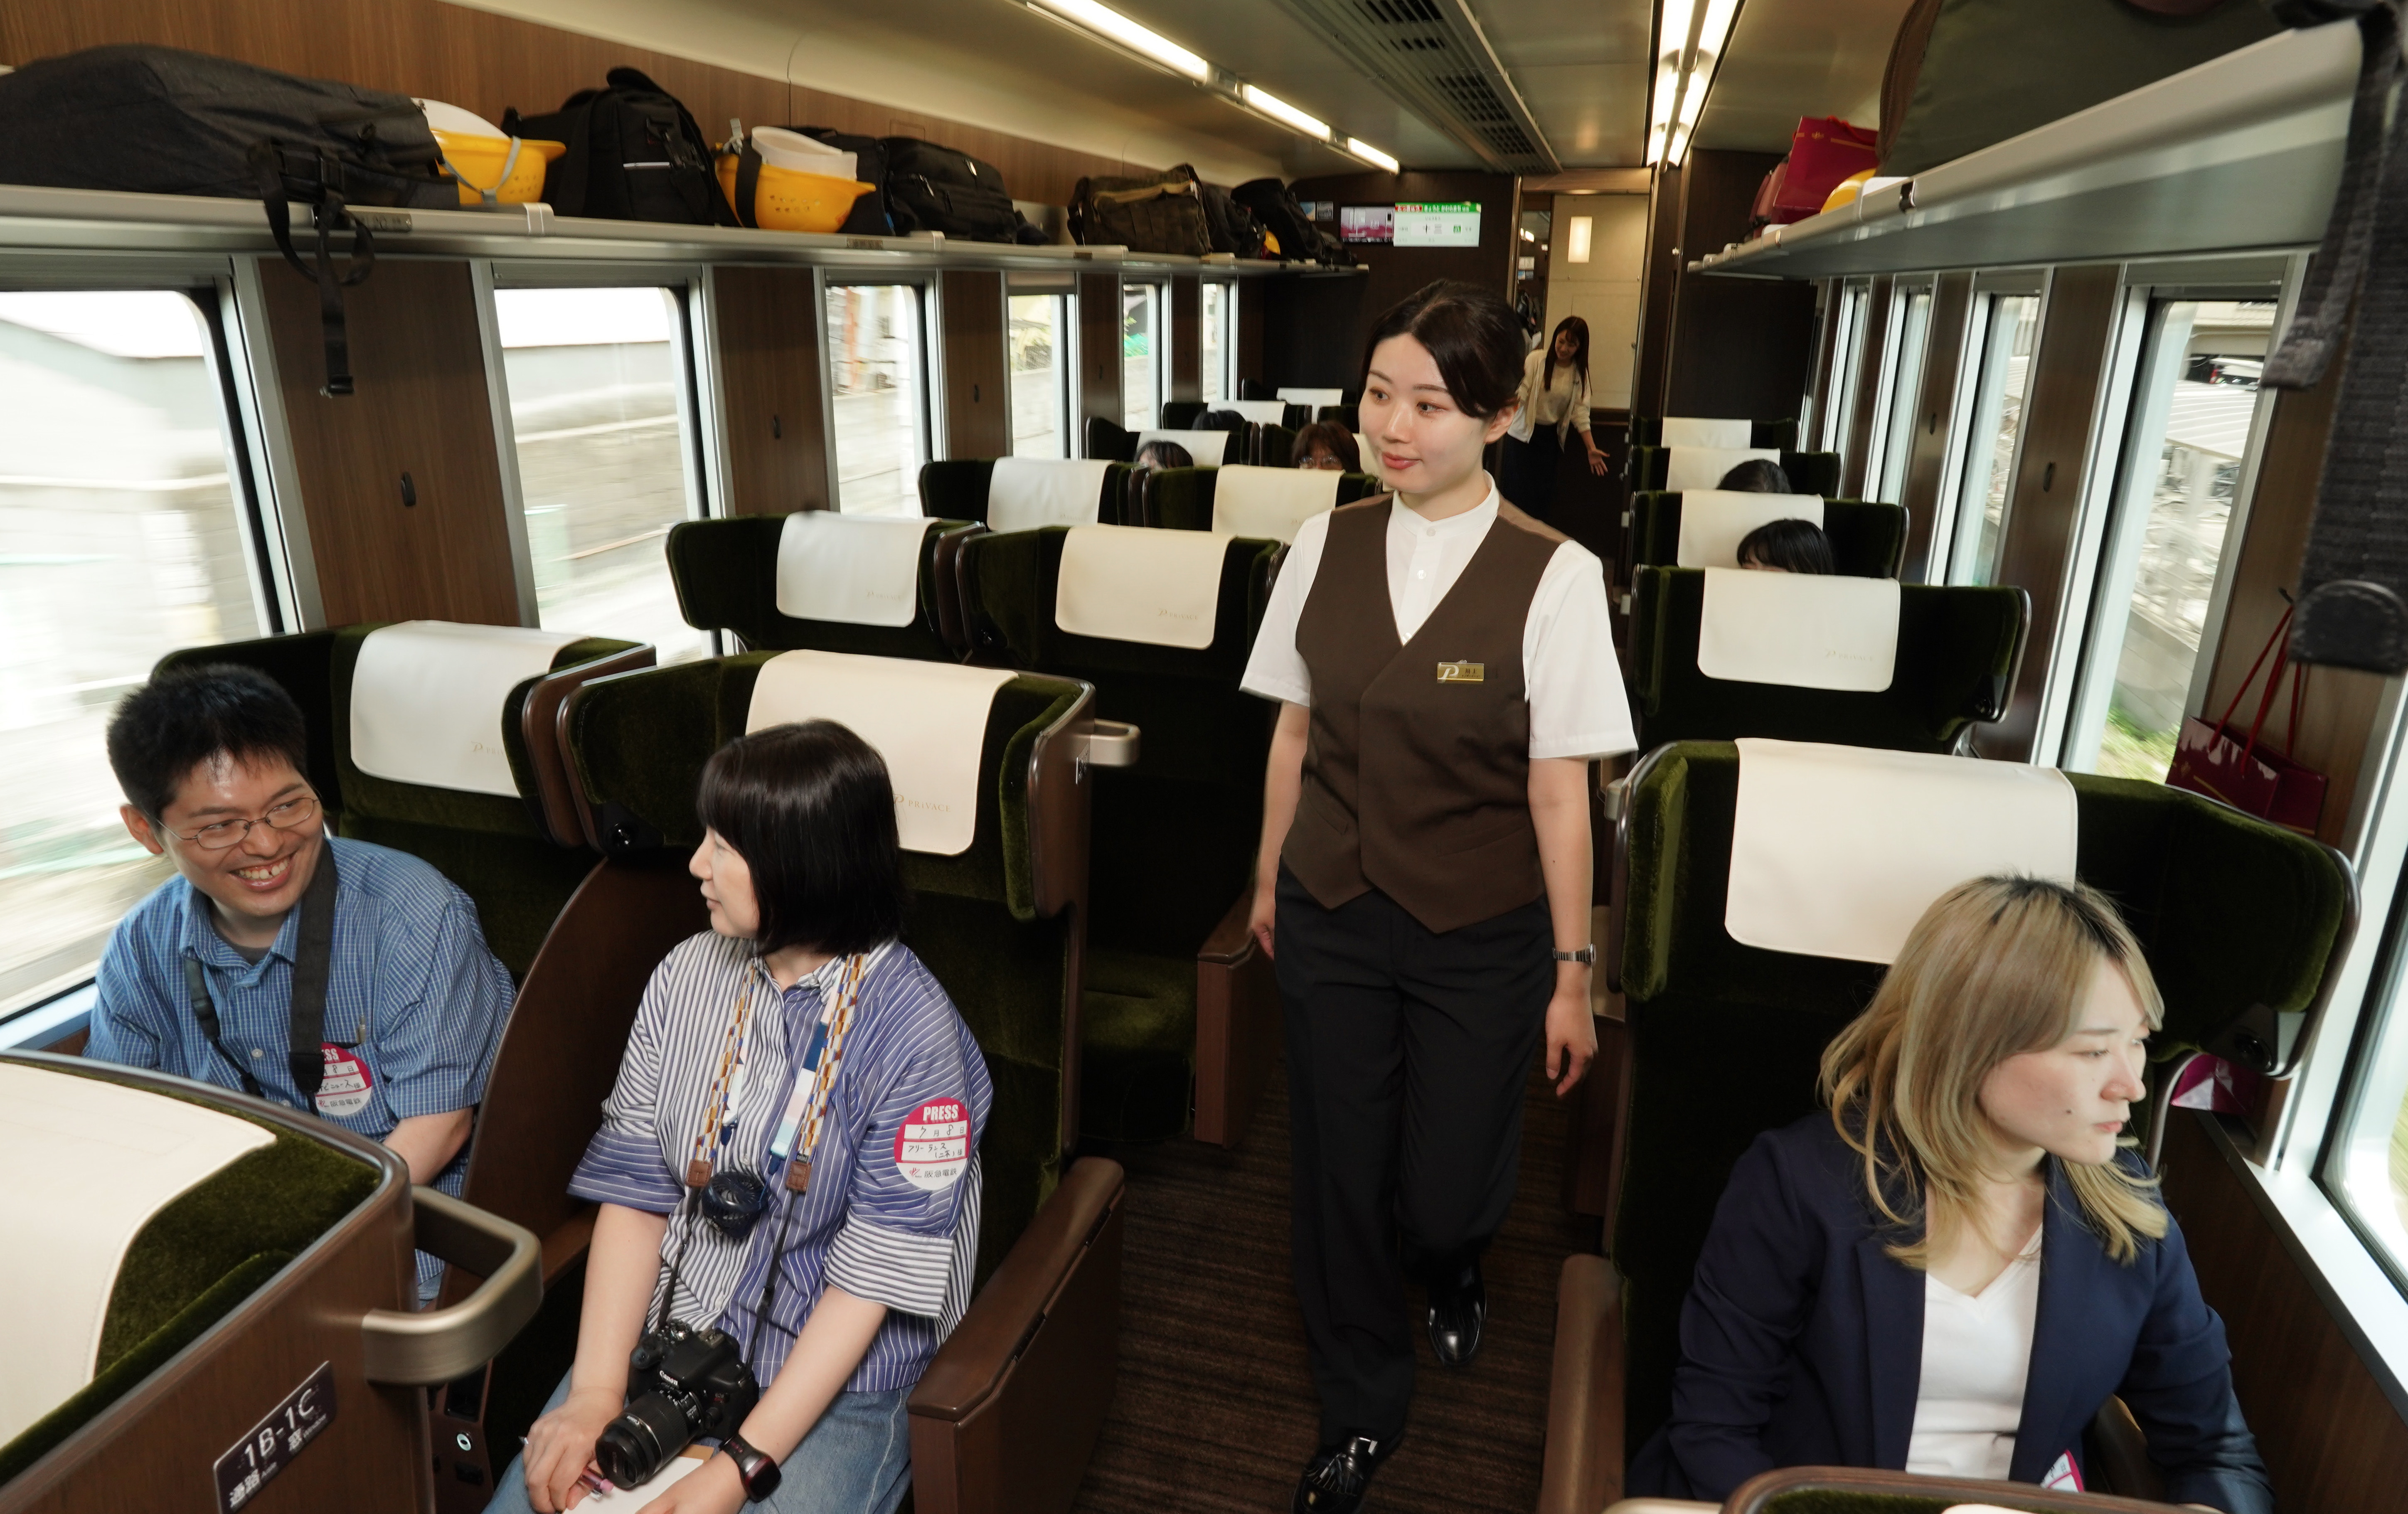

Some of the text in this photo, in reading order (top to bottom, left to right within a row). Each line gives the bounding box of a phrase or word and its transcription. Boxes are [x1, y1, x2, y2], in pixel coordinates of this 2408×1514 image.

[330, 1097, 361, 1107] 阪急電鉄
[923, 1104, 958, 1121] PRESS
[924, 1168, 957, 1178] 阪急電鉄
[659, 1370, 678, 1386] Canon
